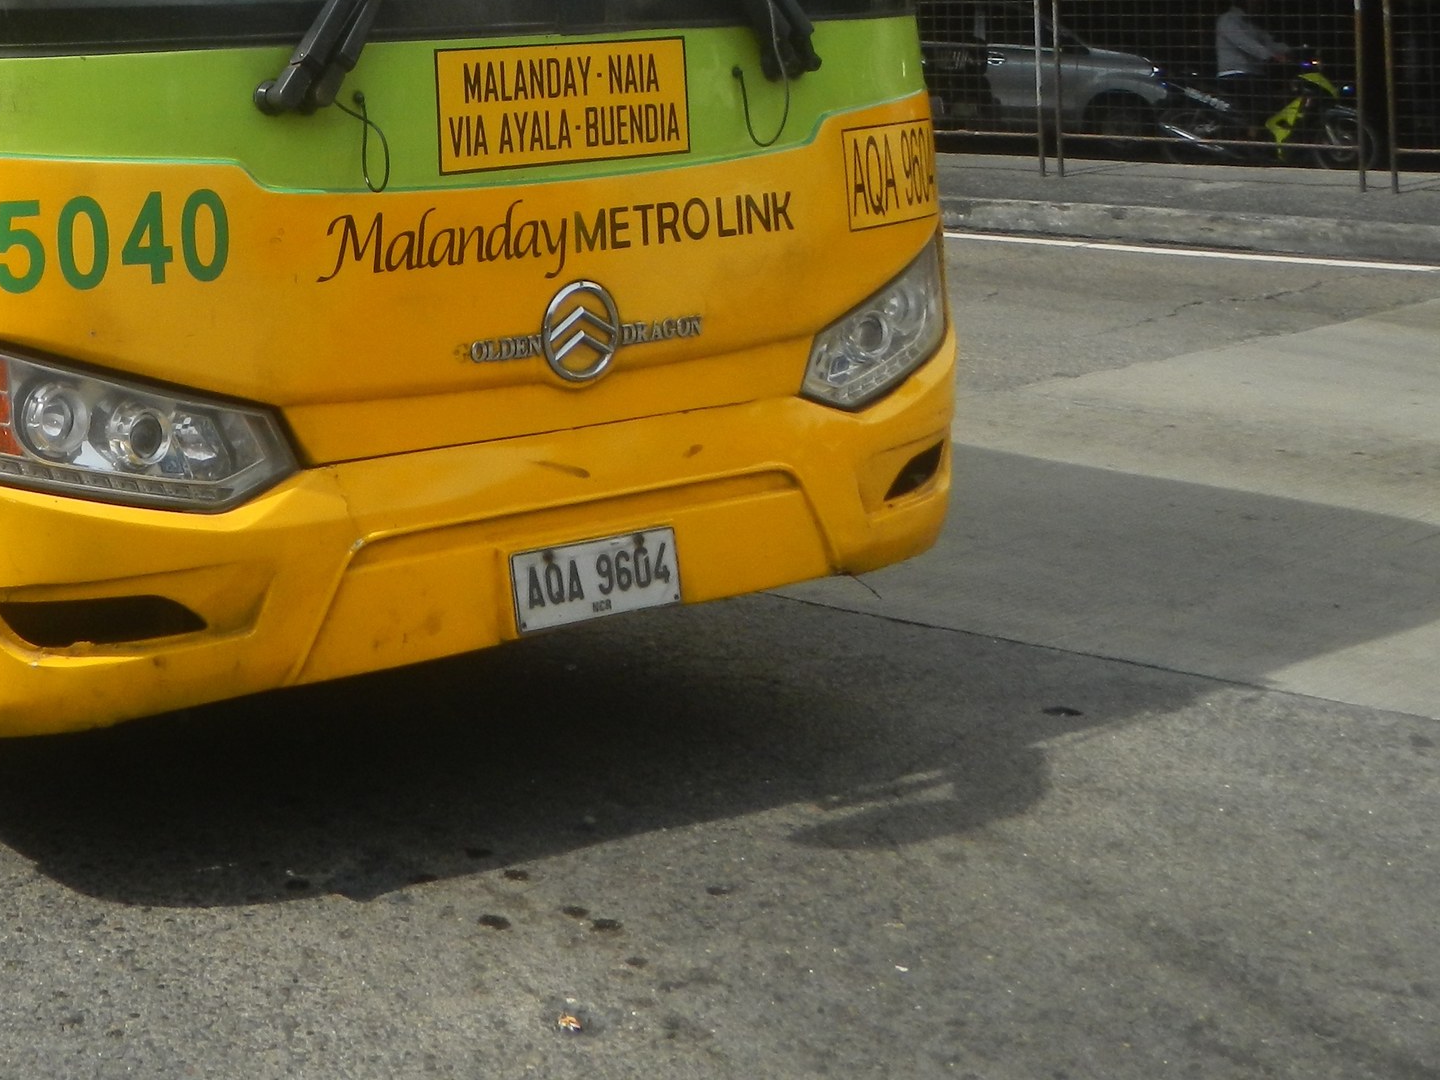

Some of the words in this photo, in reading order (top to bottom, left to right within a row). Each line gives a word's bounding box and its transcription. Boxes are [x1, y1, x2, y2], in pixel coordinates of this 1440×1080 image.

[463, 55, 592, 104] MALANDAY
[608, 52, 660, 95] NAIA
[448, 114, 489, 158] VIA
[498, 108, 572, 155] AYALA
[584, 102, 681, 149] BUENDIA
[853, 133, 900, 217] AQA
[315, 198, 568, 283] Malanday
[573, 196, 710, 253] METRO
[715, 190, 795, 239] LINK
[620, 314, 703, 346] DRAGON
[527, 559, 586, 610] AQA
[595, 541, 672, 596] 9604
